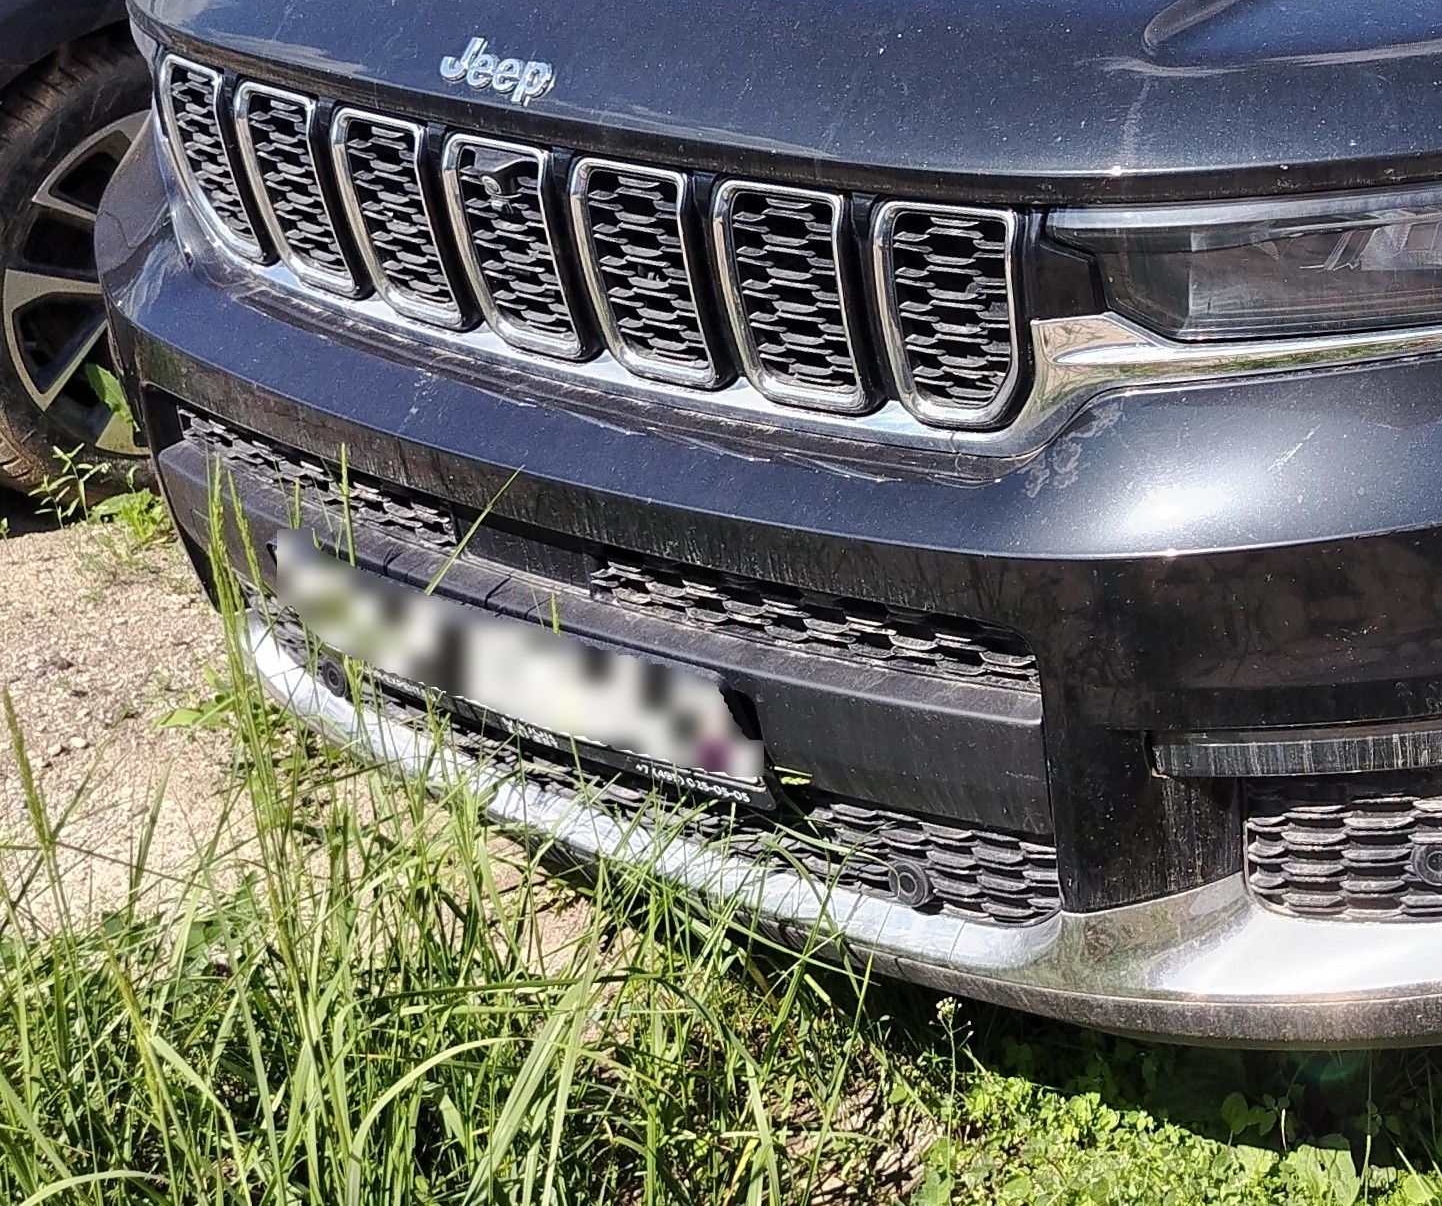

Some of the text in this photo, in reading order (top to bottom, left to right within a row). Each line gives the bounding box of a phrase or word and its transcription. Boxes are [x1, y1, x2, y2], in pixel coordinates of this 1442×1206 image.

[440, 36, 556, 106] Jeep
[635, 763, 649, 774] +7
[686, 775, 751, 803] 025-05-05
